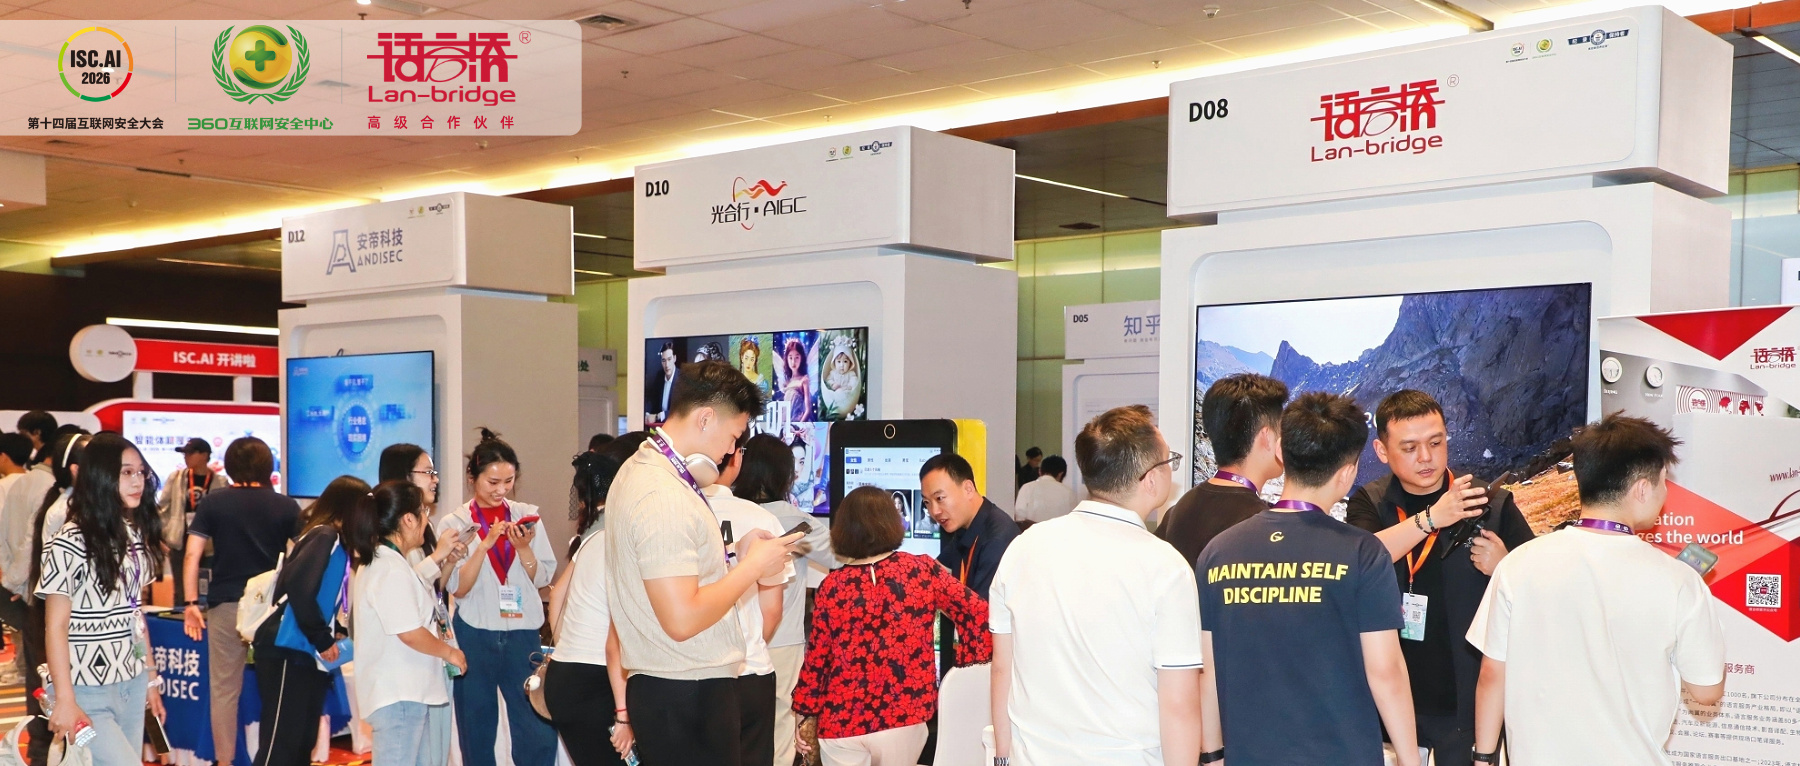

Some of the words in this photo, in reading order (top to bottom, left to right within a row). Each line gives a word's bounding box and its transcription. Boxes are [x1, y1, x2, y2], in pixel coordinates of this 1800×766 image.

[1188, 98, 1229, 122] D08
[1311, 134, 1443, 162] Lan-bridge
[645, 179, 670, 197] D10
[288, 229, 306, 243] D12
[357, 228, 404, 250] 安帝科技
[357, 250, 404, 267] ANDISEC
[1073, 314, 1089, 323] D05
[1123, 314, 1160, 336] 知乎
[173, 351, 214, 366] ISC.AI
[216, 353, 256, 368] 开讲啦
[1769, 466, 1800, 483] www.lan-
[1666, 530, 1693, 543] the
[1697, 530, 1744, 545] world
[1208, 562, 1298, 584] MAINTAIN
[1300, 561, 1349, 581] SELF
[1223, 586, 1323, 605] DISCIPLINE
[152, 646, 200, 677] 帝科技
